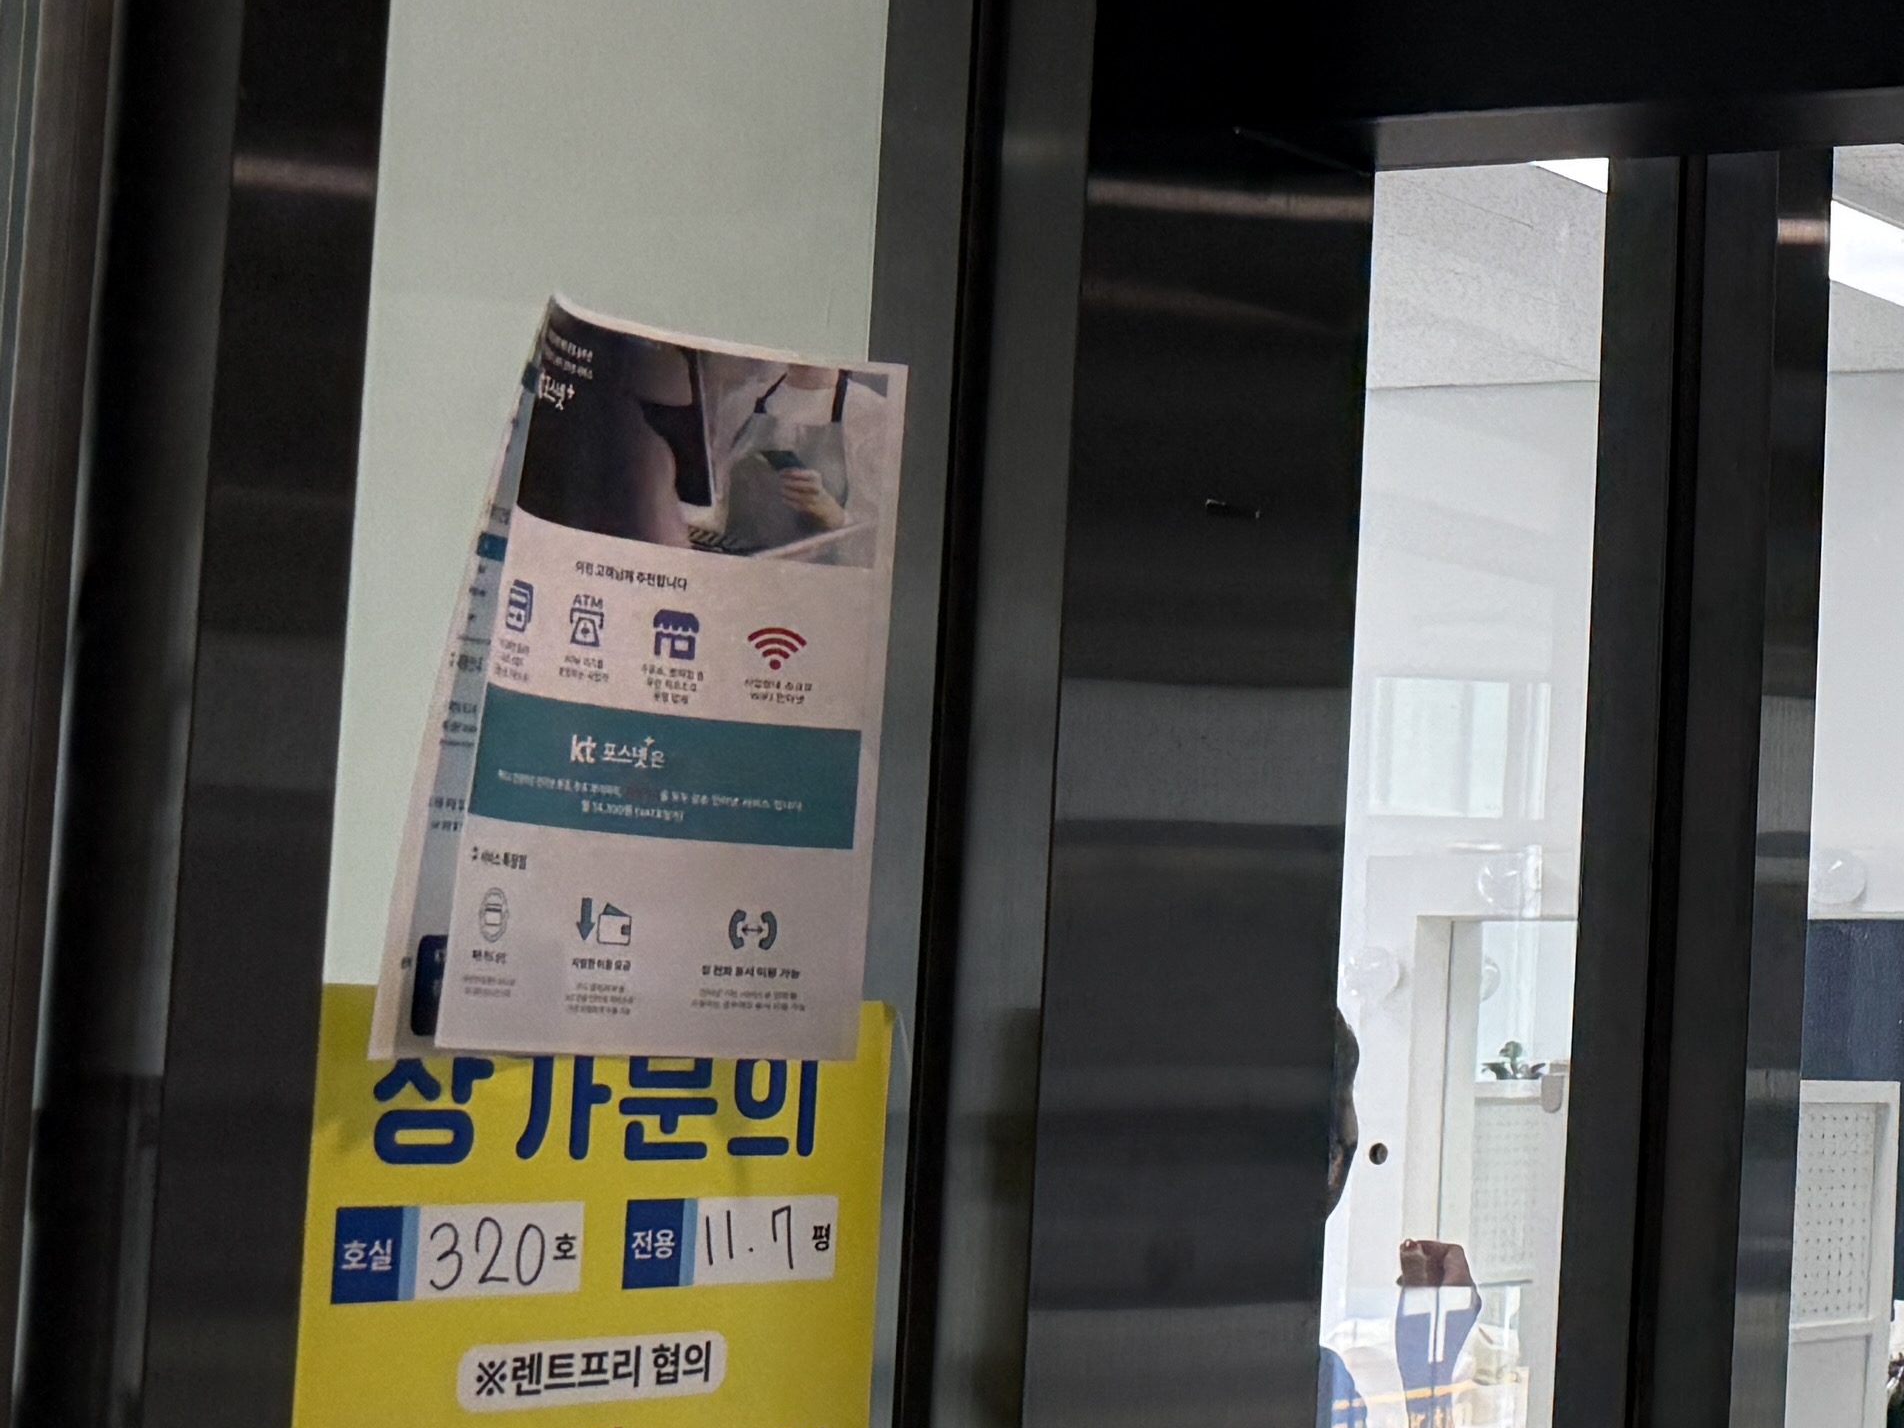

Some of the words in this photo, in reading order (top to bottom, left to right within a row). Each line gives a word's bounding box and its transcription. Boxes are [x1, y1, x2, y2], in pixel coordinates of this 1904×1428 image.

[573, 593, 604, 609] ATM
[569, 733, 597, 765] kt
[342, 1238, 394, 1272] 호실
[631, 1228, 677, 1261] 전용
[811, 1223, 832, 1254] 평
[650, 1340, 713, 1387] 협의
